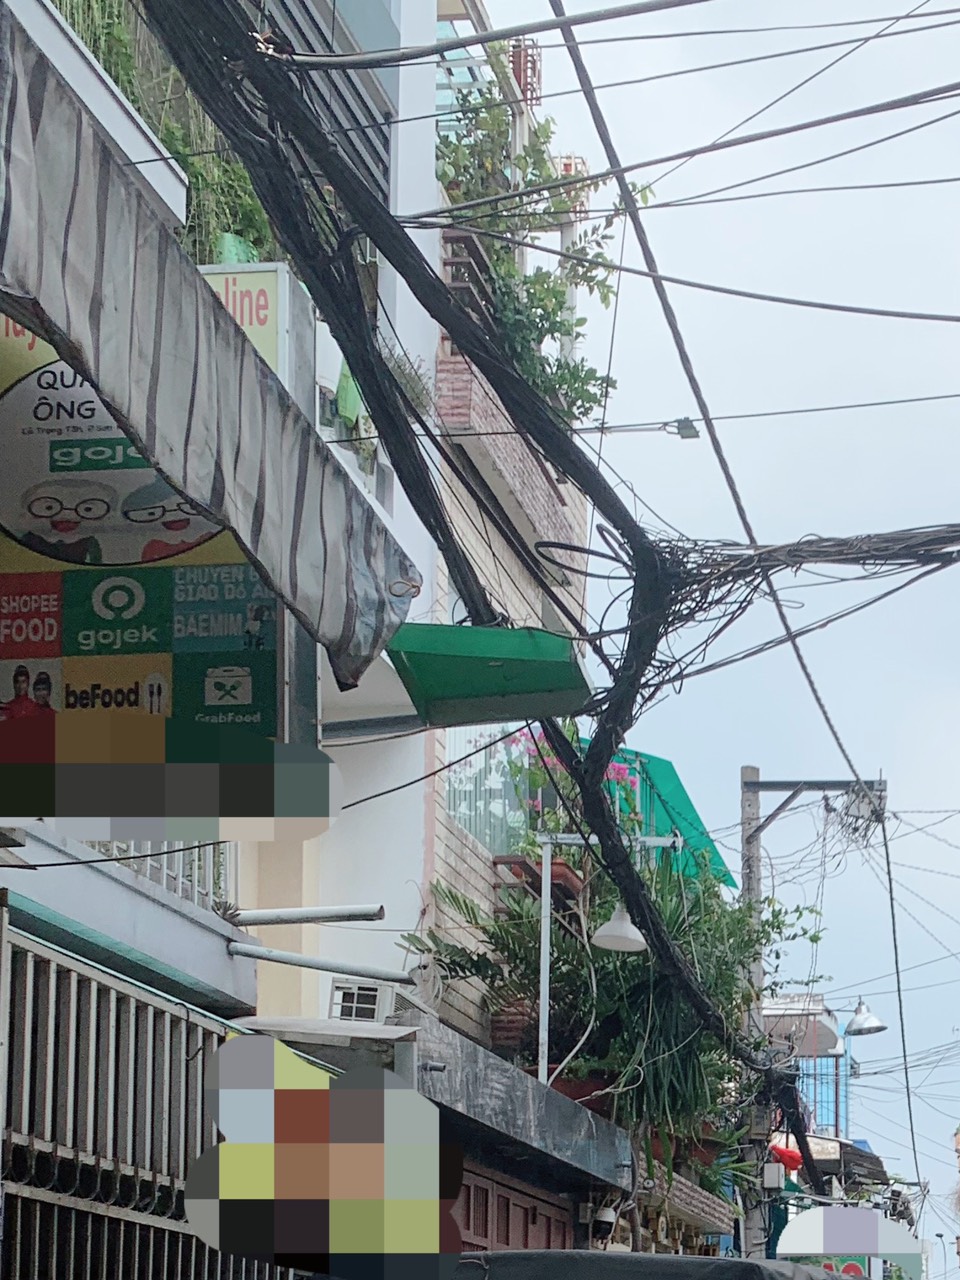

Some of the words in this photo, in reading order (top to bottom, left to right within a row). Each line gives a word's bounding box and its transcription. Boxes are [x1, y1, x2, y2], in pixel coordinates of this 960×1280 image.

[215, 277, 269, 326] line
[37, 370, 87, 391] QU
[33, 396, 96, 421] ÔNG
[0, 618, 58, 643] FOOD
[77, 625, 159, 650] gojek
[65, 681, 140, 709] beFood
